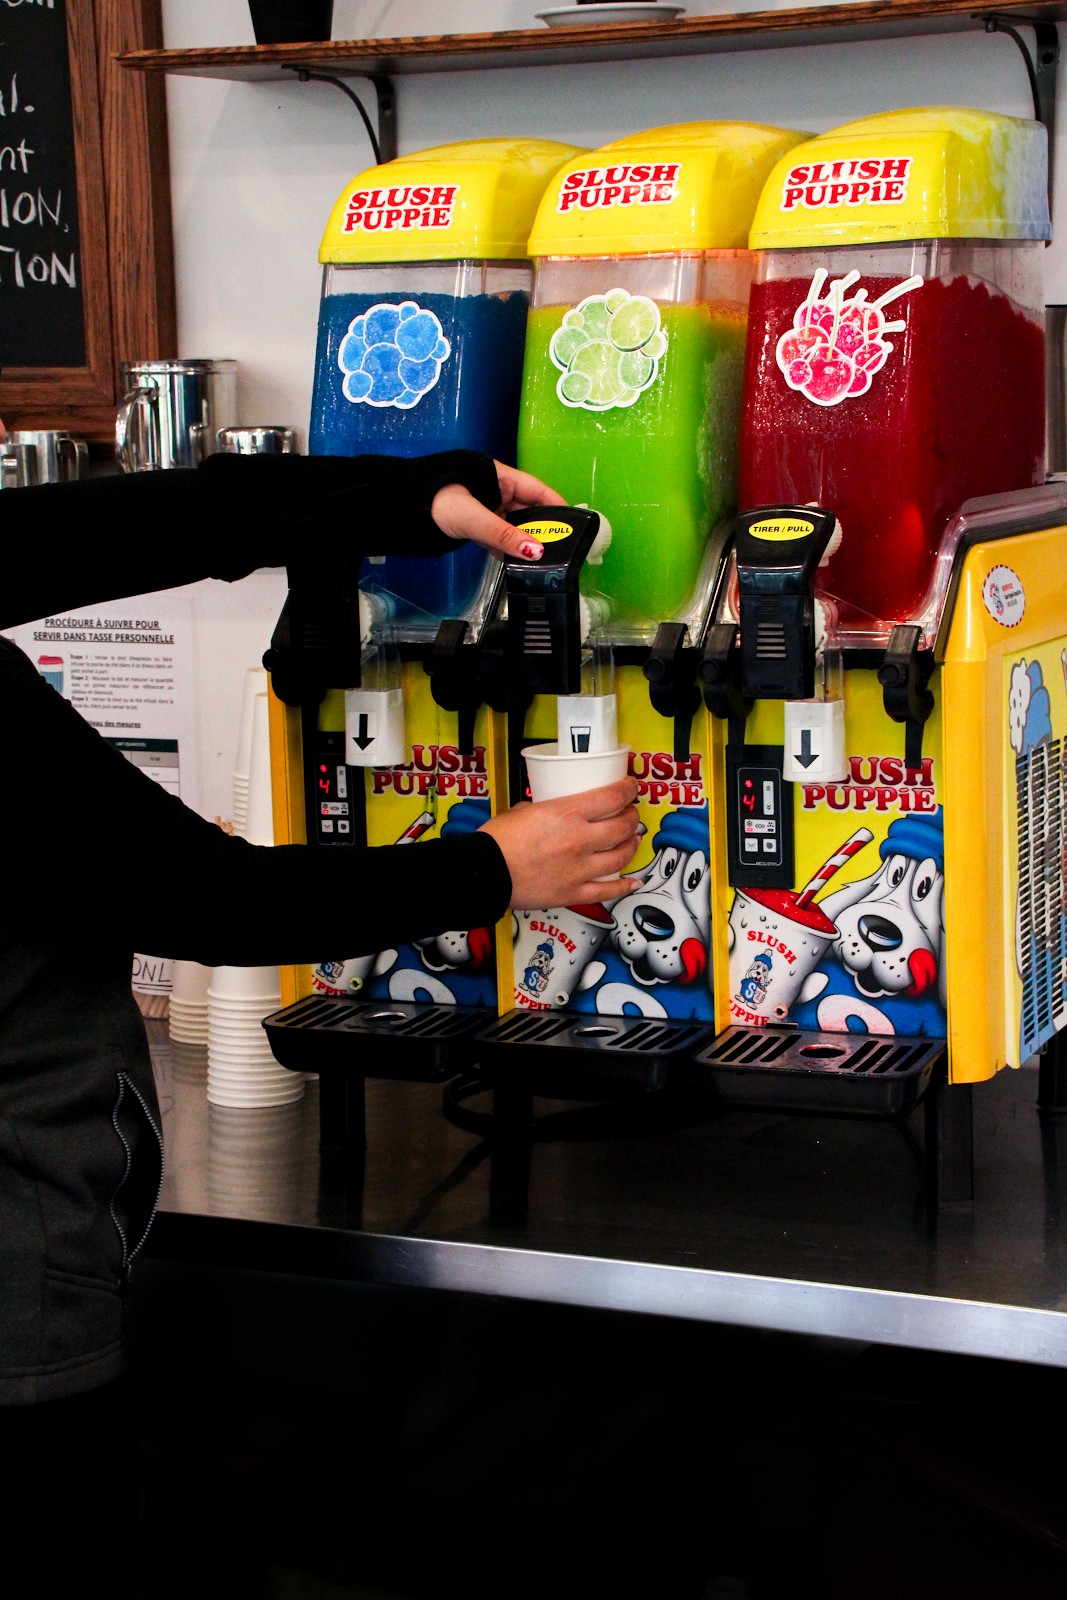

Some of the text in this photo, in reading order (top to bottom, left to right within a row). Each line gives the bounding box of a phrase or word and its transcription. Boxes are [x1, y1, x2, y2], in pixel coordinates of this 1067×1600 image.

[564, 165, 679, 190] SLUSH
[787, 159, 910, 186] SLUSH
[349, 187, 457, 210] SLUSH
[45, 617, 160, 629] PROCÉDURE À SUIVRE POUR
[33, 632, 175, 644] SERVIR DANS TASSE PERSONNELLE
[373, 745, 488, 773] USH
[809, 756, 935, 786] USH
[319, 779, 330, 795] 4
[743, 795, 755, 812] 4
[529, 920, 577, 954] SLUSH
[747, 930, 797, 965] SLUSH
[528, 971, 540, 987] S
[745, 982, 757, 999] S
